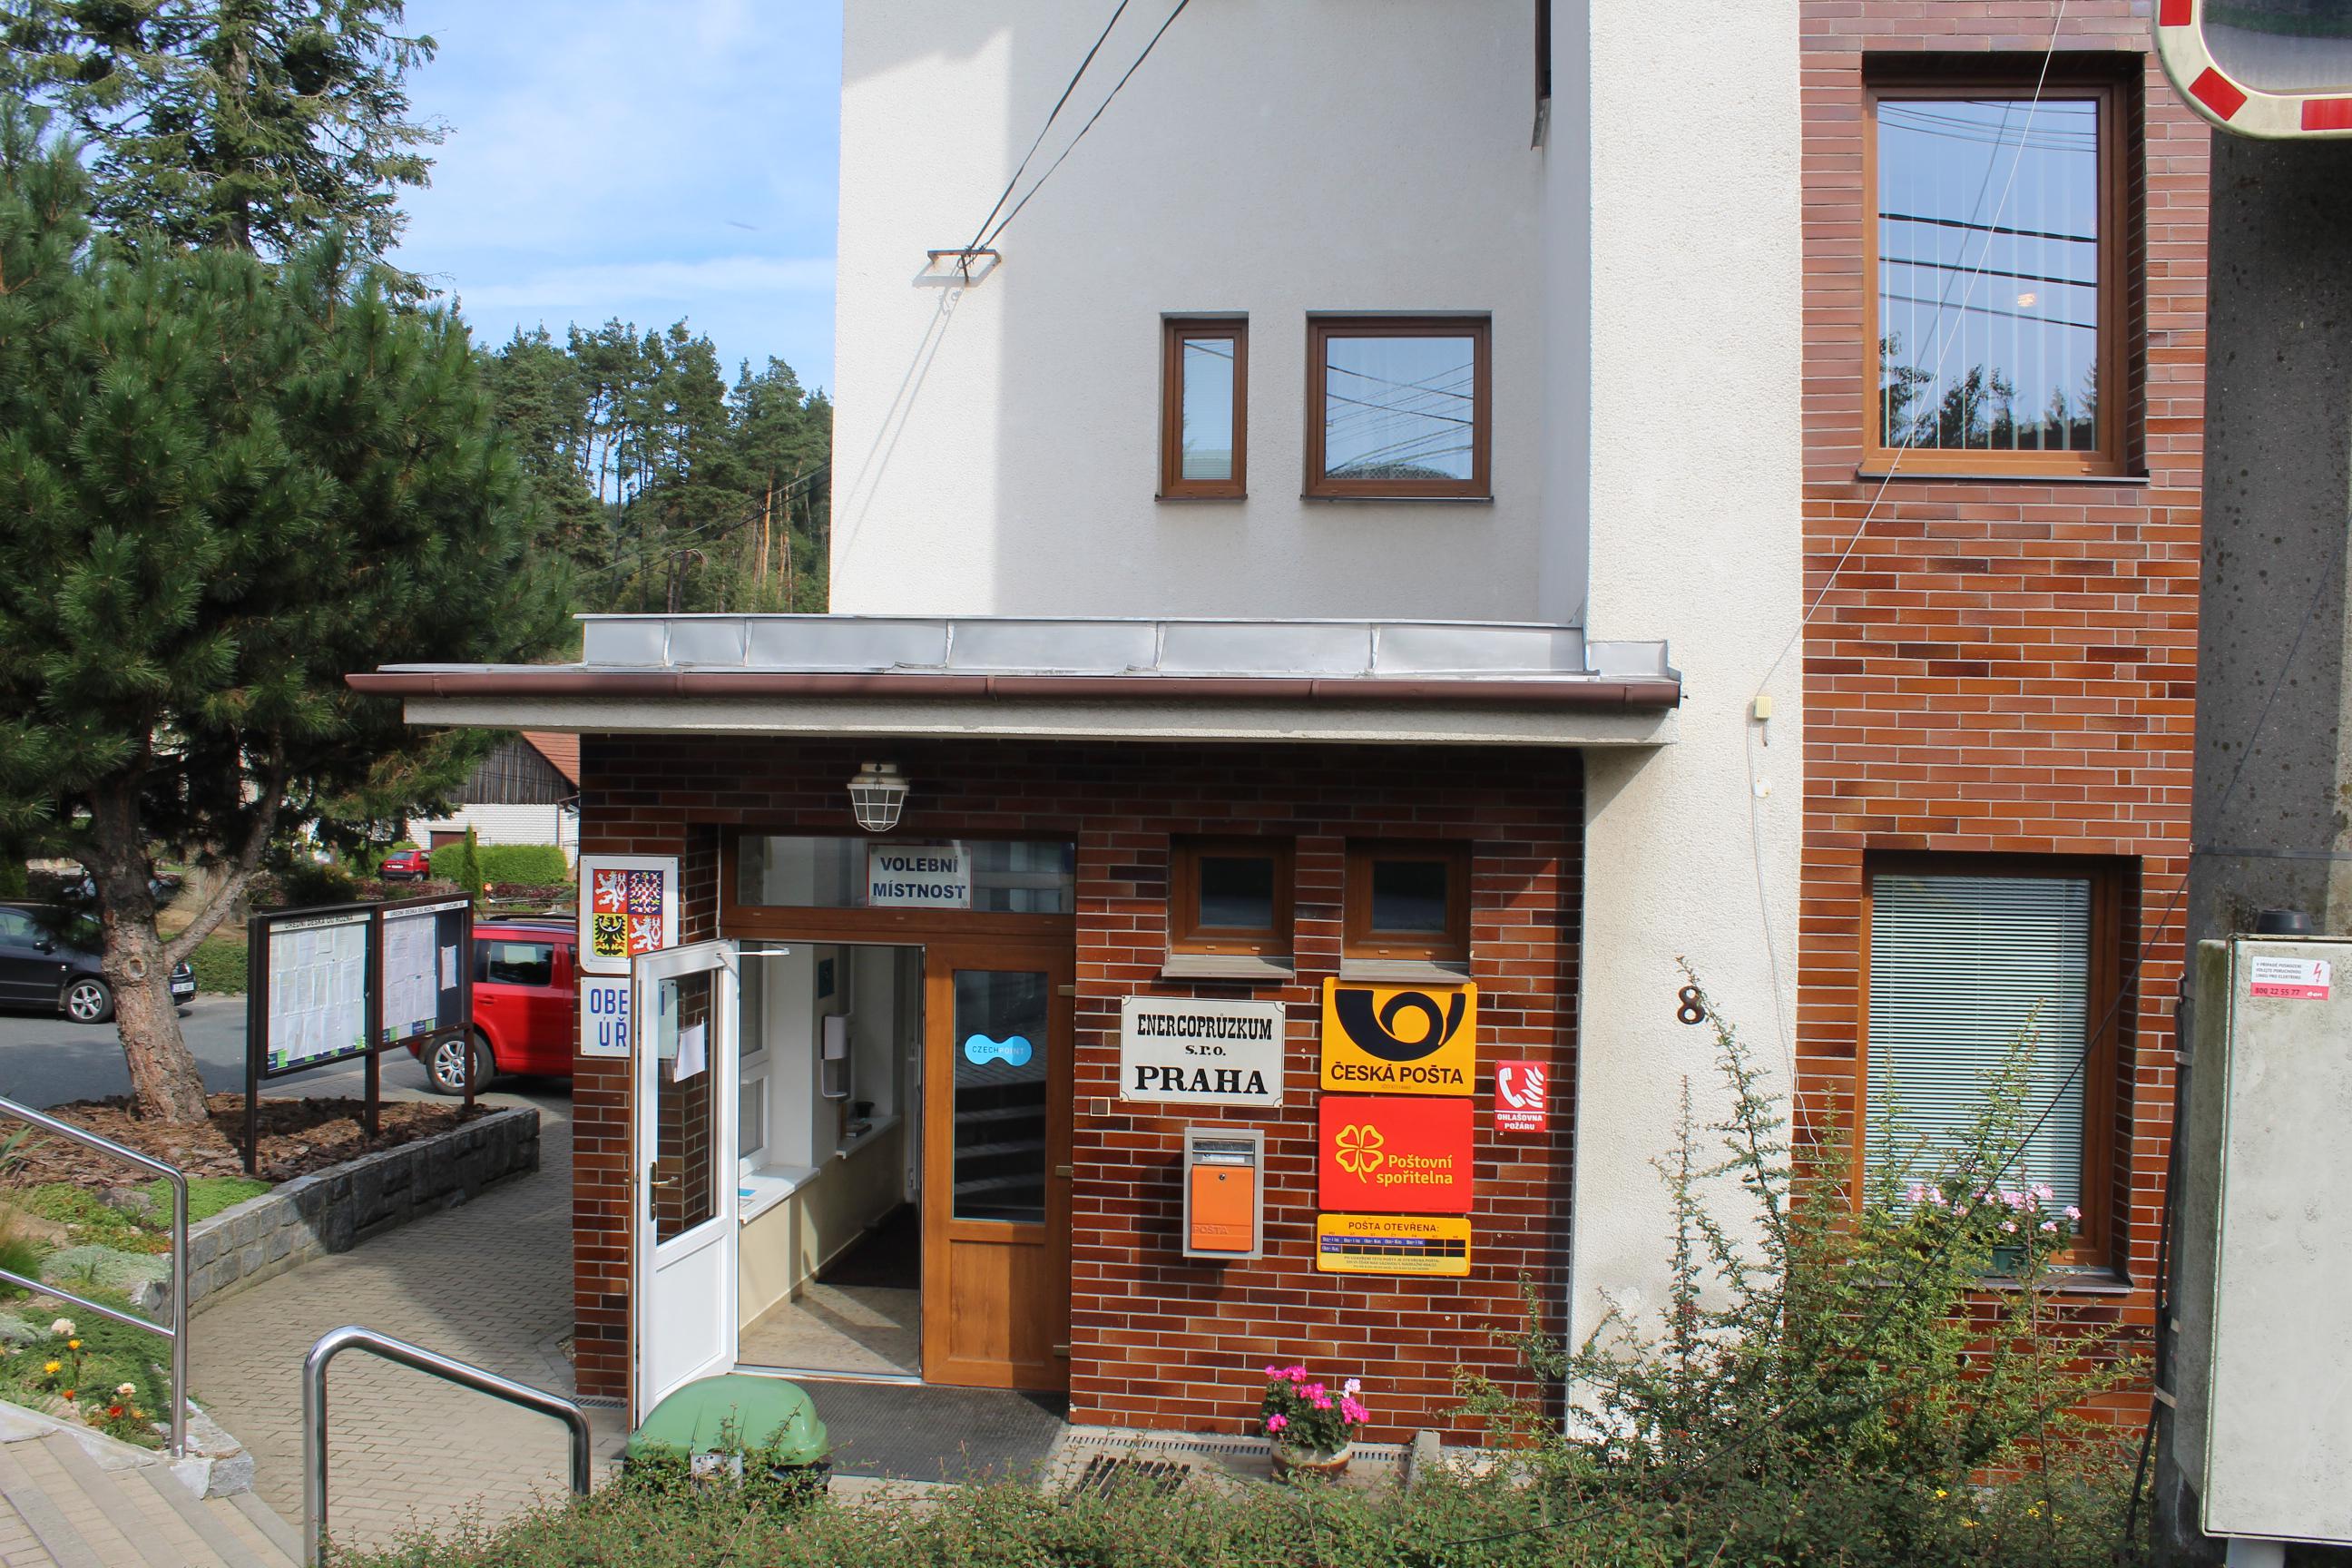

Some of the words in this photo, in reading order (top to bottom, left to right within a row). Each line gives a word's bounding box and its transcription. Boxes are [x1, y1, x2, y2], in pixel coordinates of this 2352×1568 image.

[880, 856, 958, 873] VOLEBNÍ
[873, 880, 965, 898] MÍSTNOST
[1677, 985, 1705, 1024] 8
[1137, 1013, 1272, 1040] ENERGOPRŮZKUM
[1185, 1044, 1227, 1056] s.r.o.
[1135, 1065, 1269, 1094] PRAHA
[1331, 1062, 1396, 1082] ČESKÁ
[1400, 1064, 1464, 1084] POŠTA
[1496, 1112, 1544, 1122] OHLAŠOVNA
[1504, 1122, 1535, 1130] POŽÁRU
[1388, 1154, 1453, 1170] Poštovní
[1376, 1170, 1453, 1187] spořitelna
[1348, 1220, 1380, 1230] POŠTA
[1384, 1221, 1439, 1232] OTEVŘENA:
